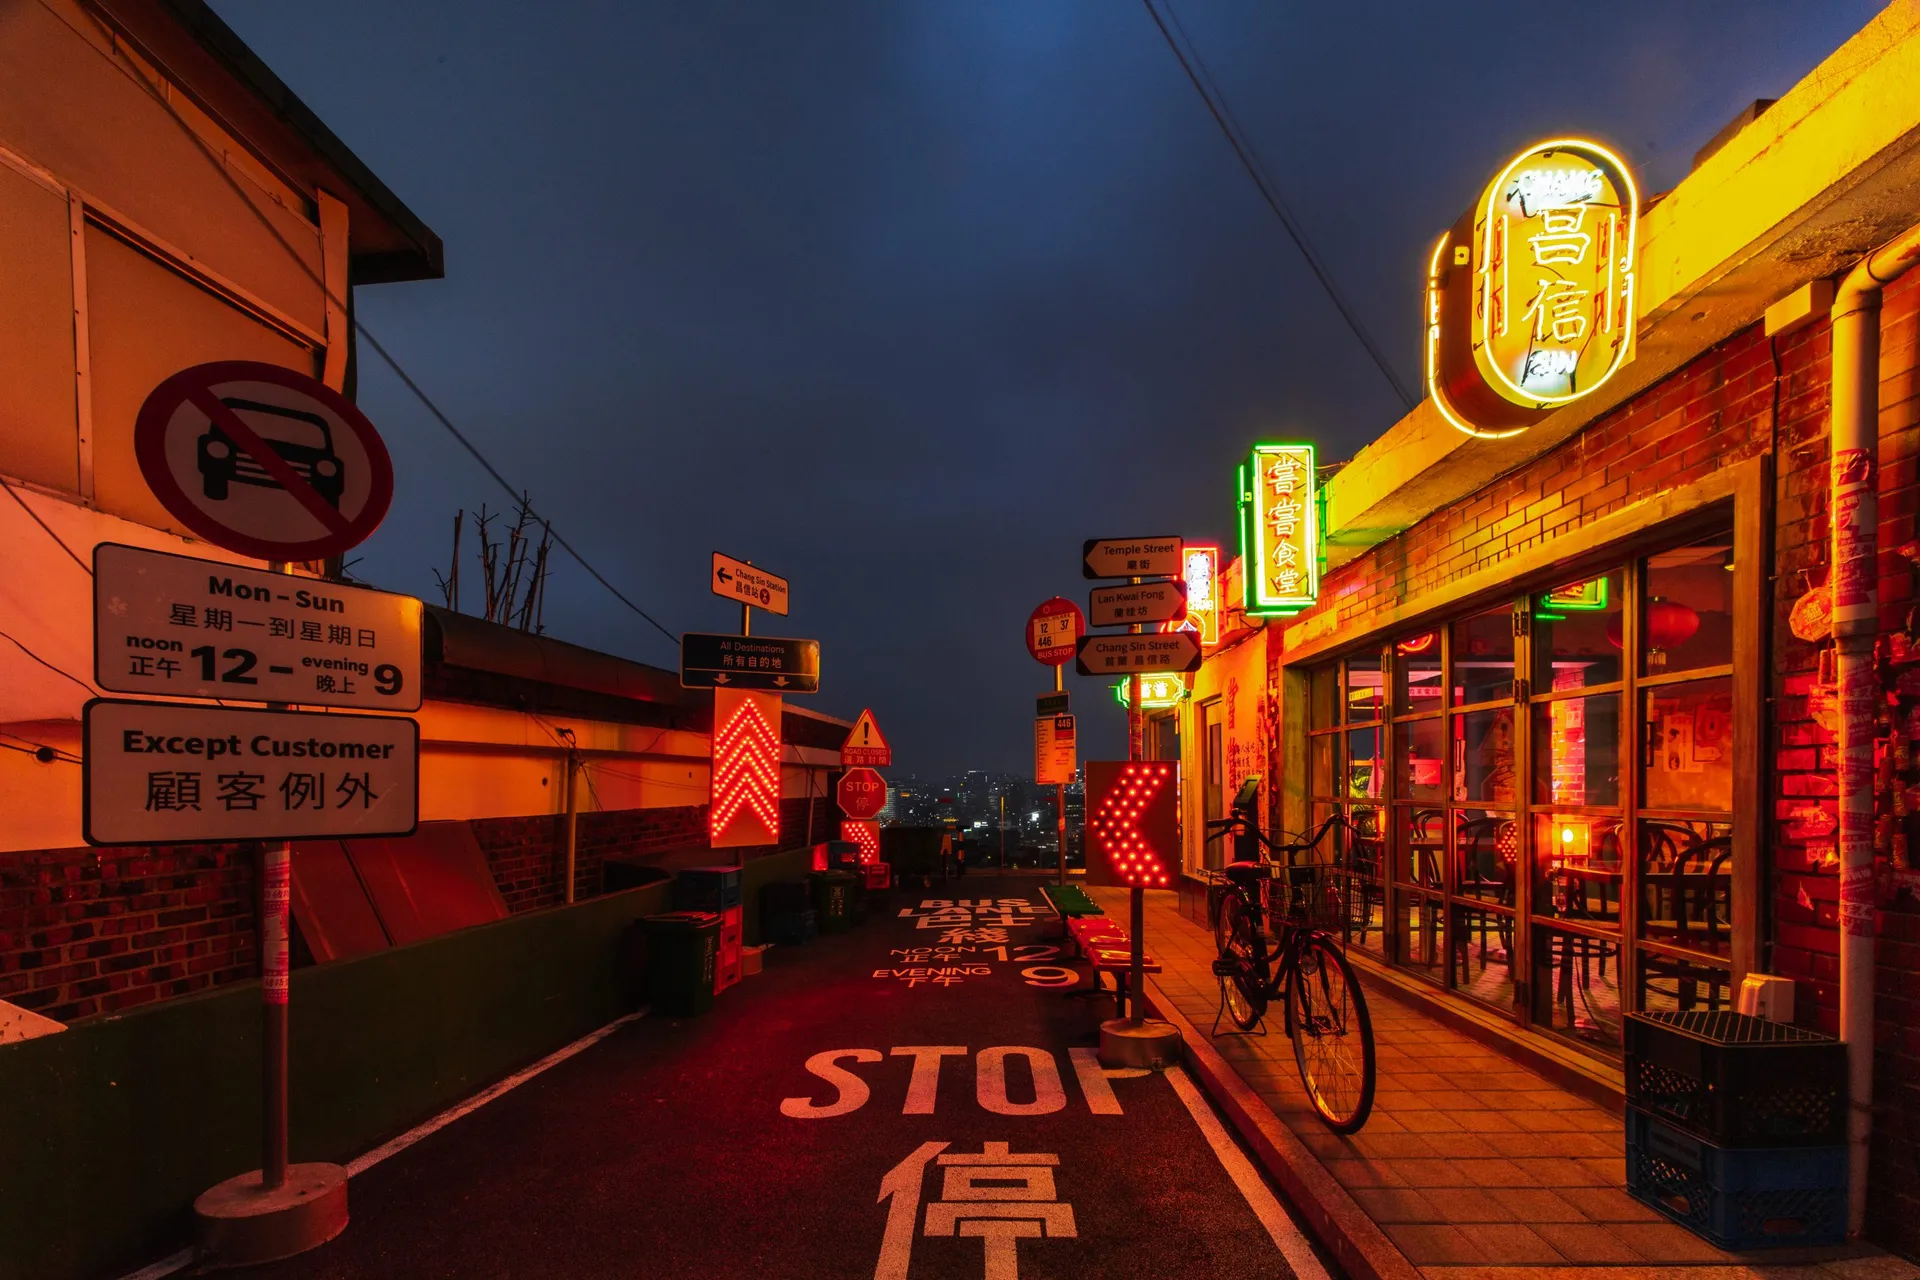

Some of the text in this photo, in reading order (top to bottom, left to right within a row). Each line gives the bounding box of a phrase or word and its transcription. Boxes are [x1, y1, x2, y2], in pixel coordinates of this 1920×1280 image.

[1522, 202, 1591, 342] 昌信
[1104, 543, 1174, 556] Temple Street
[735, 568, 786, 593] Chang Sin Station
[209, 576, 271, 602] Mon
[296, 590, 345, 613] Sun
[736, 581, 758, 599] 昌信站
[1098, 591, 1165, 604] Lan Kwai Fong
[1114, 607, 1148, 618] 蘭桂坊
[169, 603, 376, 648] 星期一到星期日
[1040, 623, 1048, 634] 12
[1060, 619, 1069, 630] 37
[126, 635, 183, 652] noon
[720, 641, 785, 653] All Destinations
[1038, 636, 1052, 647] 446
[1096, 640, 1180, 654] Chang Sin Street
[1038, 648, 1073, 659] BUS STOP
[129, 656, 182, 679] 正午
[191, 645, 258, 685] 12
[302, 655, 369, 676] evening
[316, 675, 356, 694] 晚上
[374, 664, 403, 695] 9
[1058, 719, 1071, 728] 446
[123, 730, 394, 760] Except Customer
[863, 748, 887, 756] CLOSED
[145, 770, 379, 812] 顧客例外
[846, 782, 879, 792] STOP
[920, 899, 1031, 909] BUS
[898, 906, 1051, 917] LANE
[916, 914, 1036, 929] 巴士
[890, 945, 1061, 962] NOON 12
[900, 953, 962, 963] 正午
[872, 966, 1080, 987] EVENING 9
[900, 977, 964, 988] 下午
